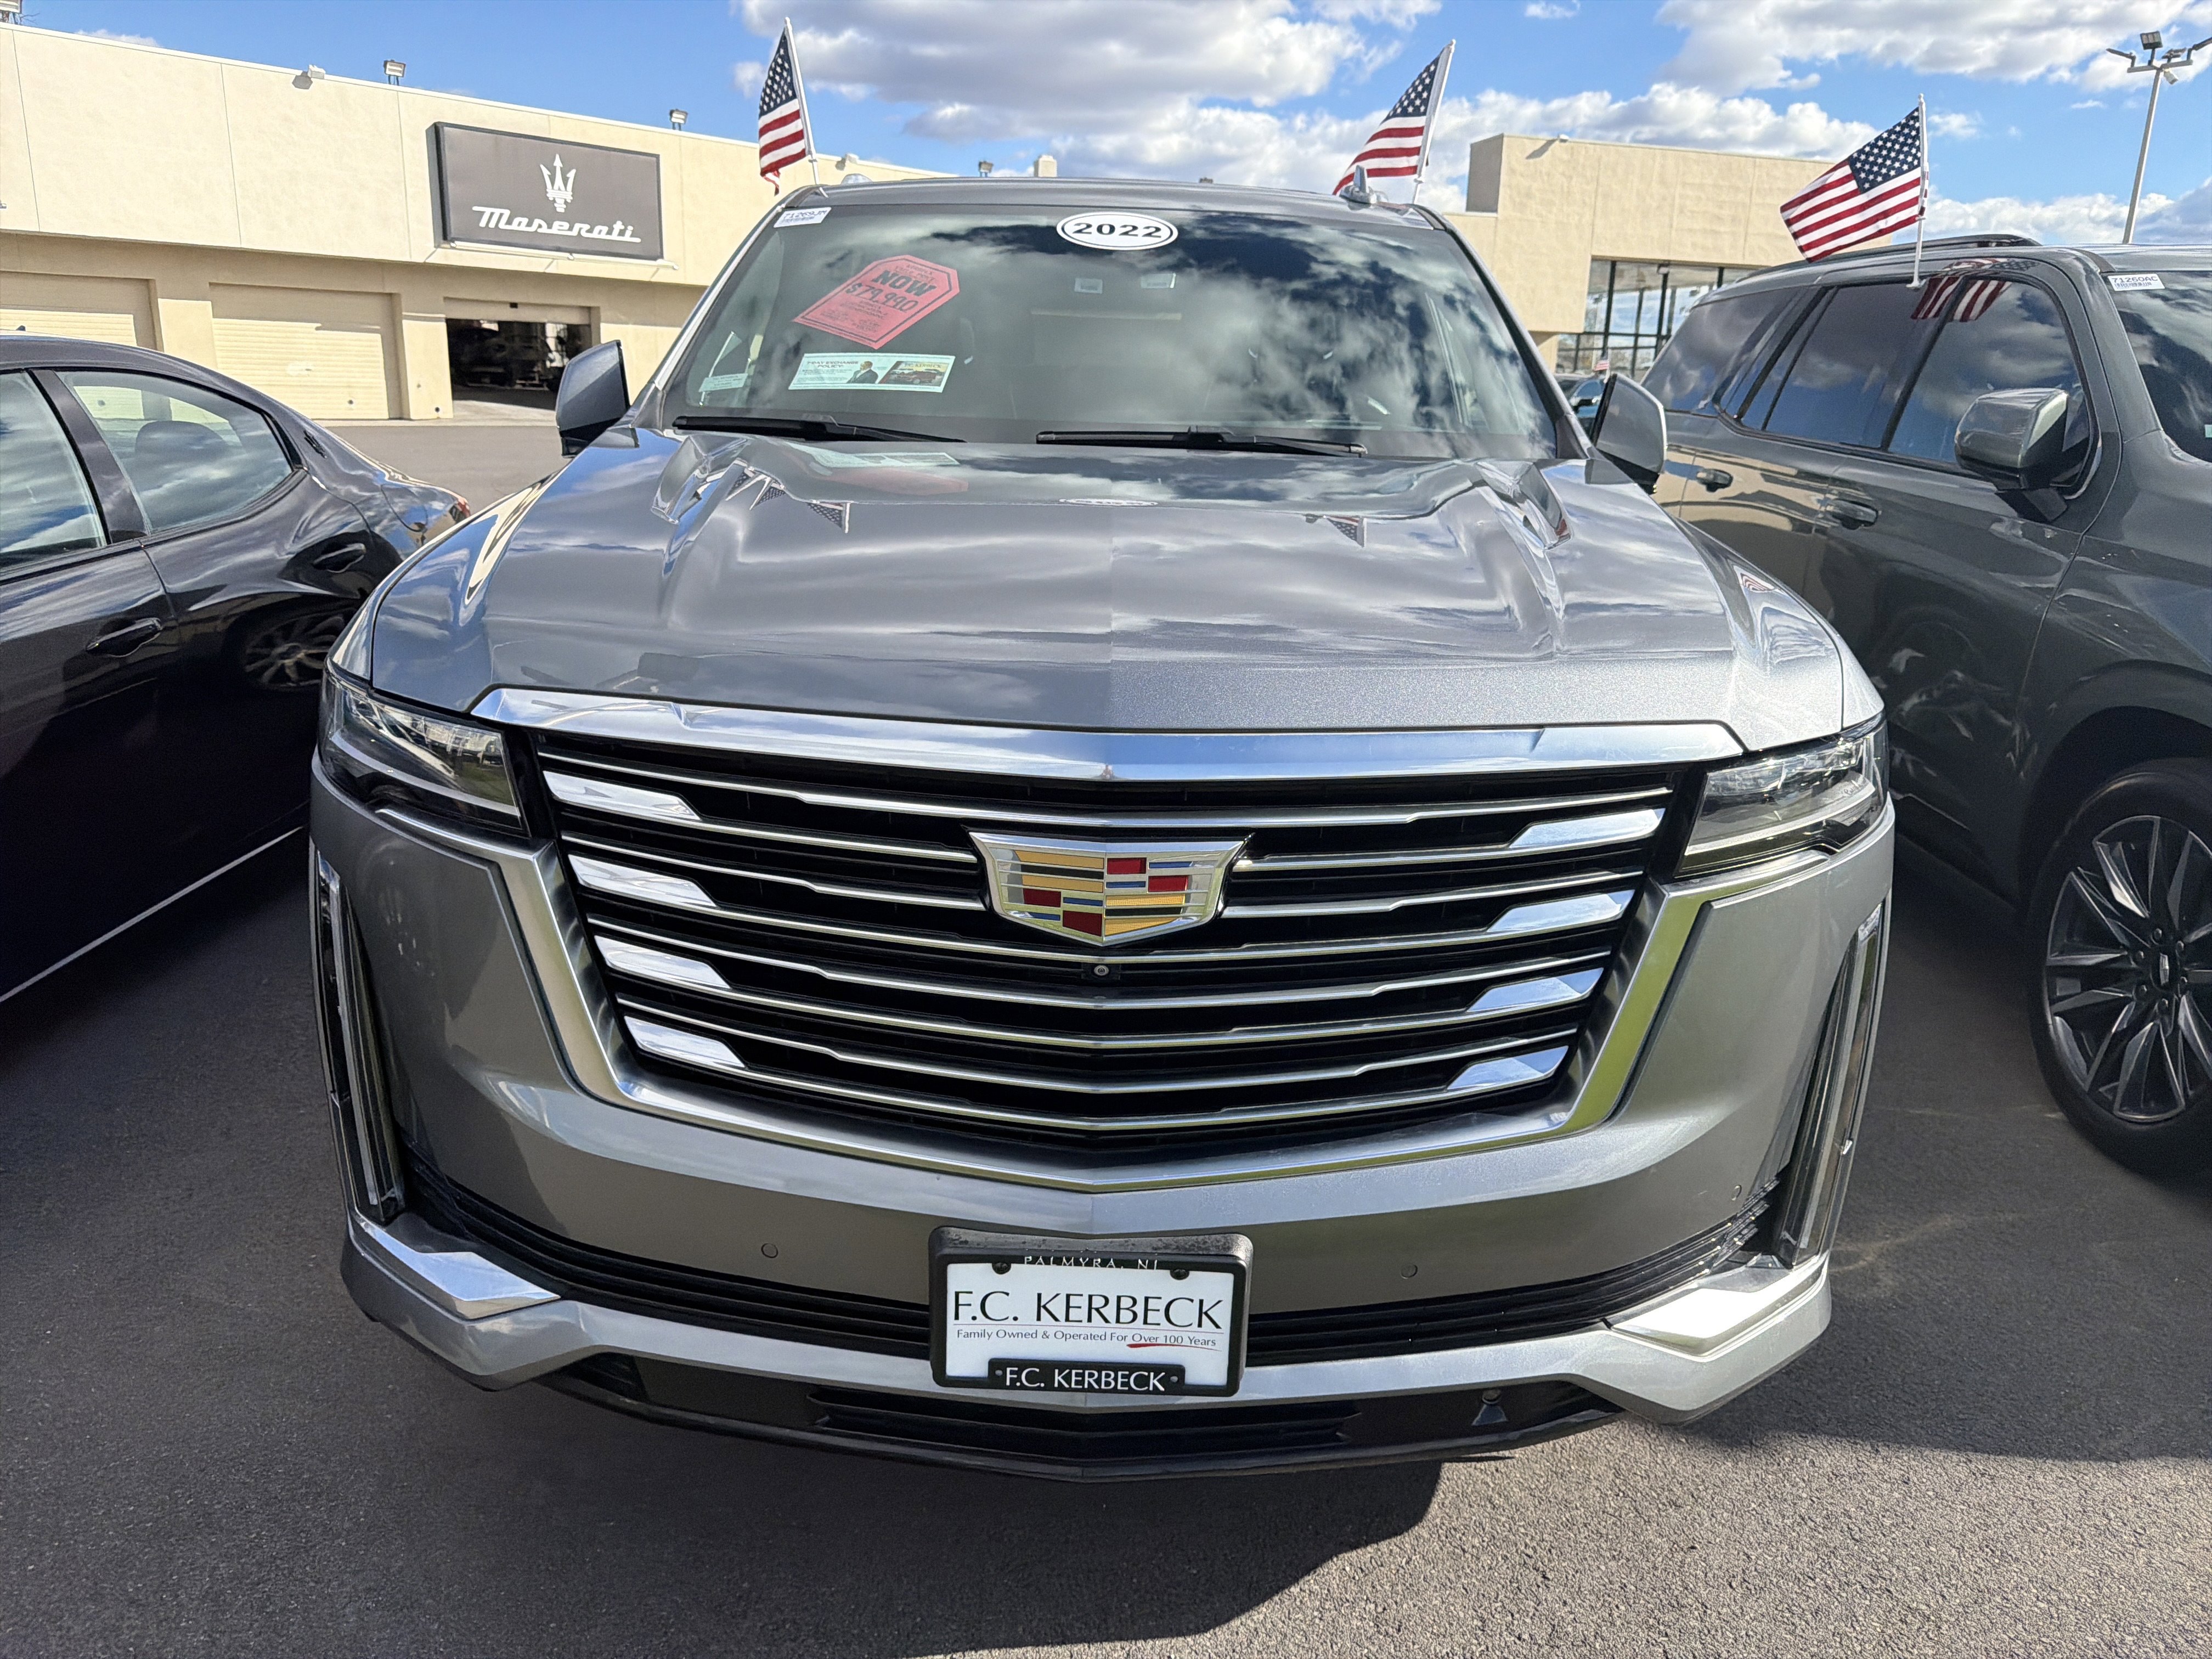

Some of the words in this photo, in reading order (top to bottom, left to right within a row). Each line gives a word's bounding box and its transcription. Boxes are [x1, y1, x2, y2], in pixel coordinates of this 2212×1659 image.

[472, 206, 641, 242] Maserati
[1072, 222, 1162, 238] 2022
[871, 270, 937, 296] NOW
[953, 1290, 1019, 1322] F.C.
[1036, 1292, 1223, 1329] KERBECK
[957, 1329, 993, 1341] Family
[996, 1329, 1038, 1340] Owned
[1042, 1330, 1049, 1339] &
[1053, 1330, 1107, 1342] Operated
[1110, 1332, 1128, 1342] For
[1132, 1333, 1159, 1343] Over
[1163, 1334, 1183, 1345] 100
[1188, 1335, 1216, 1347] Years
[1005, 1367, 1045, 1387] F.C.
[1053, 1368, 1165, 1391] KERBECK
